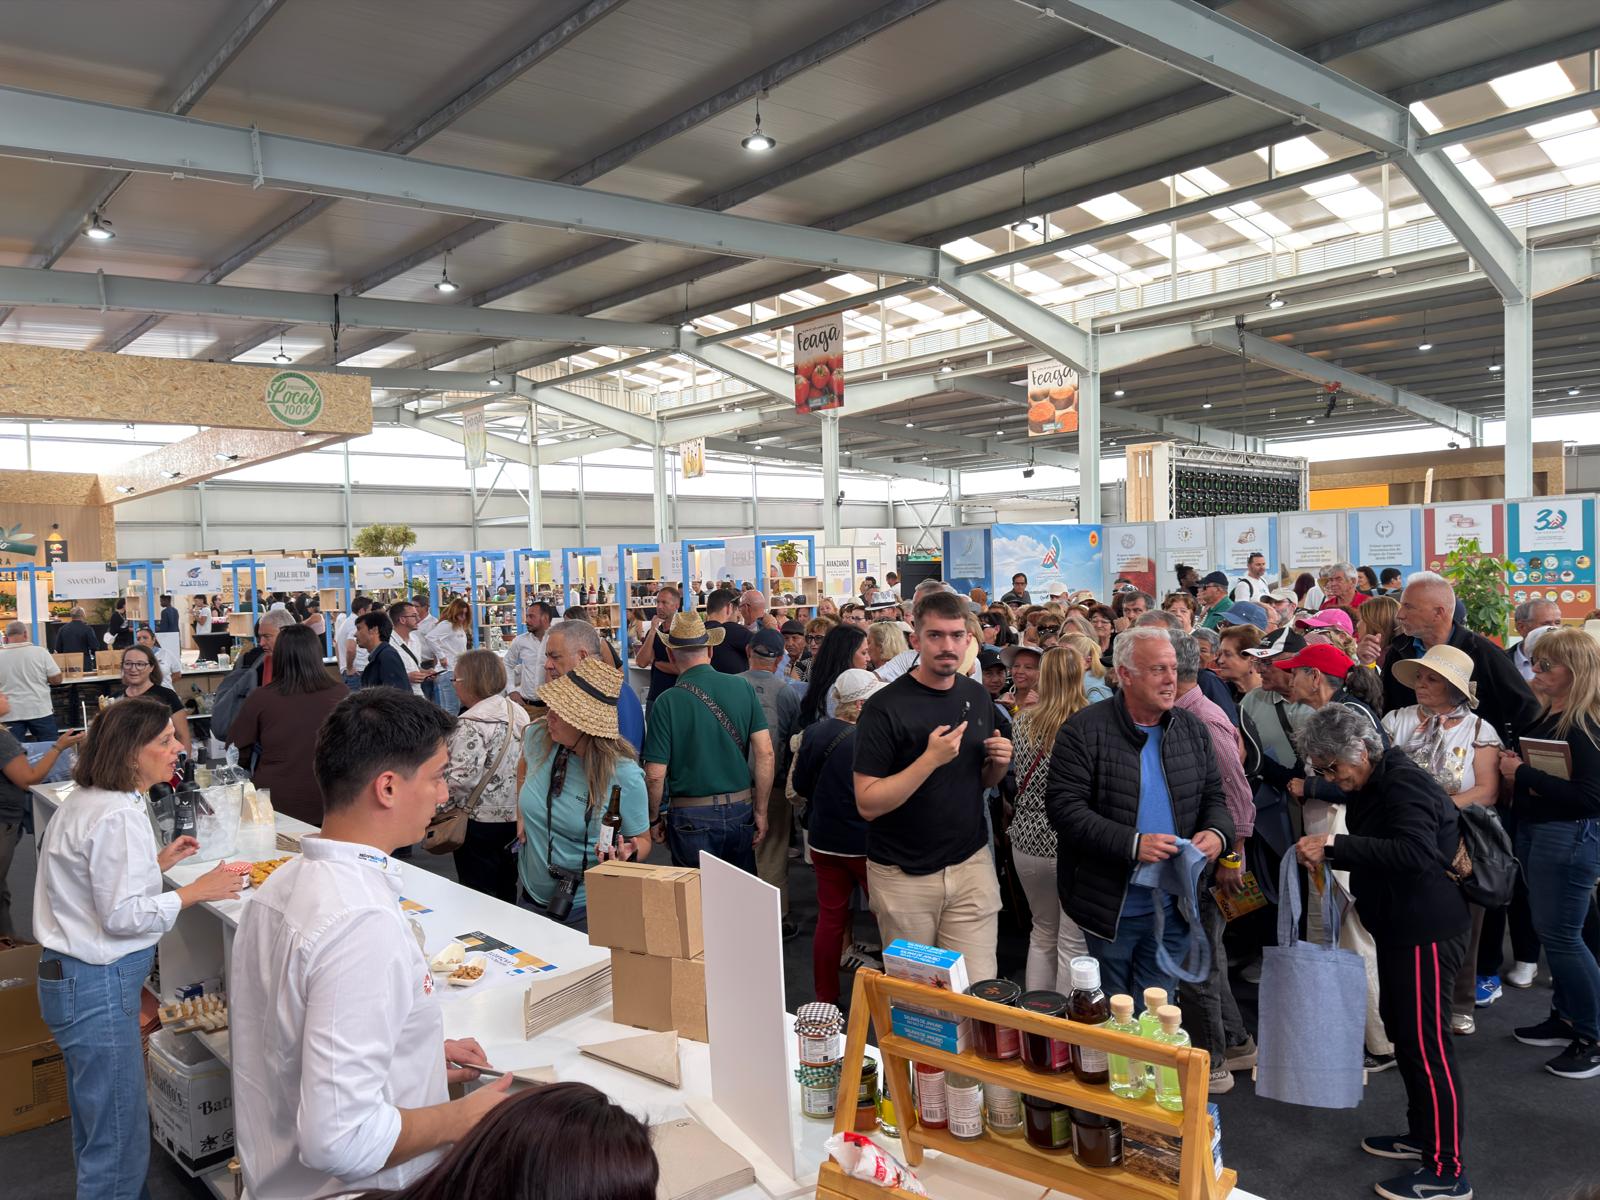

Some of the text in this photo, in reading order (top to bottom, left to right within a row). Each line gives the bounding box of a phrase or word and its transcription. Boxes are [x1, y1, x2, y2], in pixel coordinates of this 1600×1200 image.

[797, 326, 840, 352] Feaga
[1032, 366, 1074, 386] Feaga
[267, 381, 319, 405] Local
[284, 405, 310, 416] 100%
